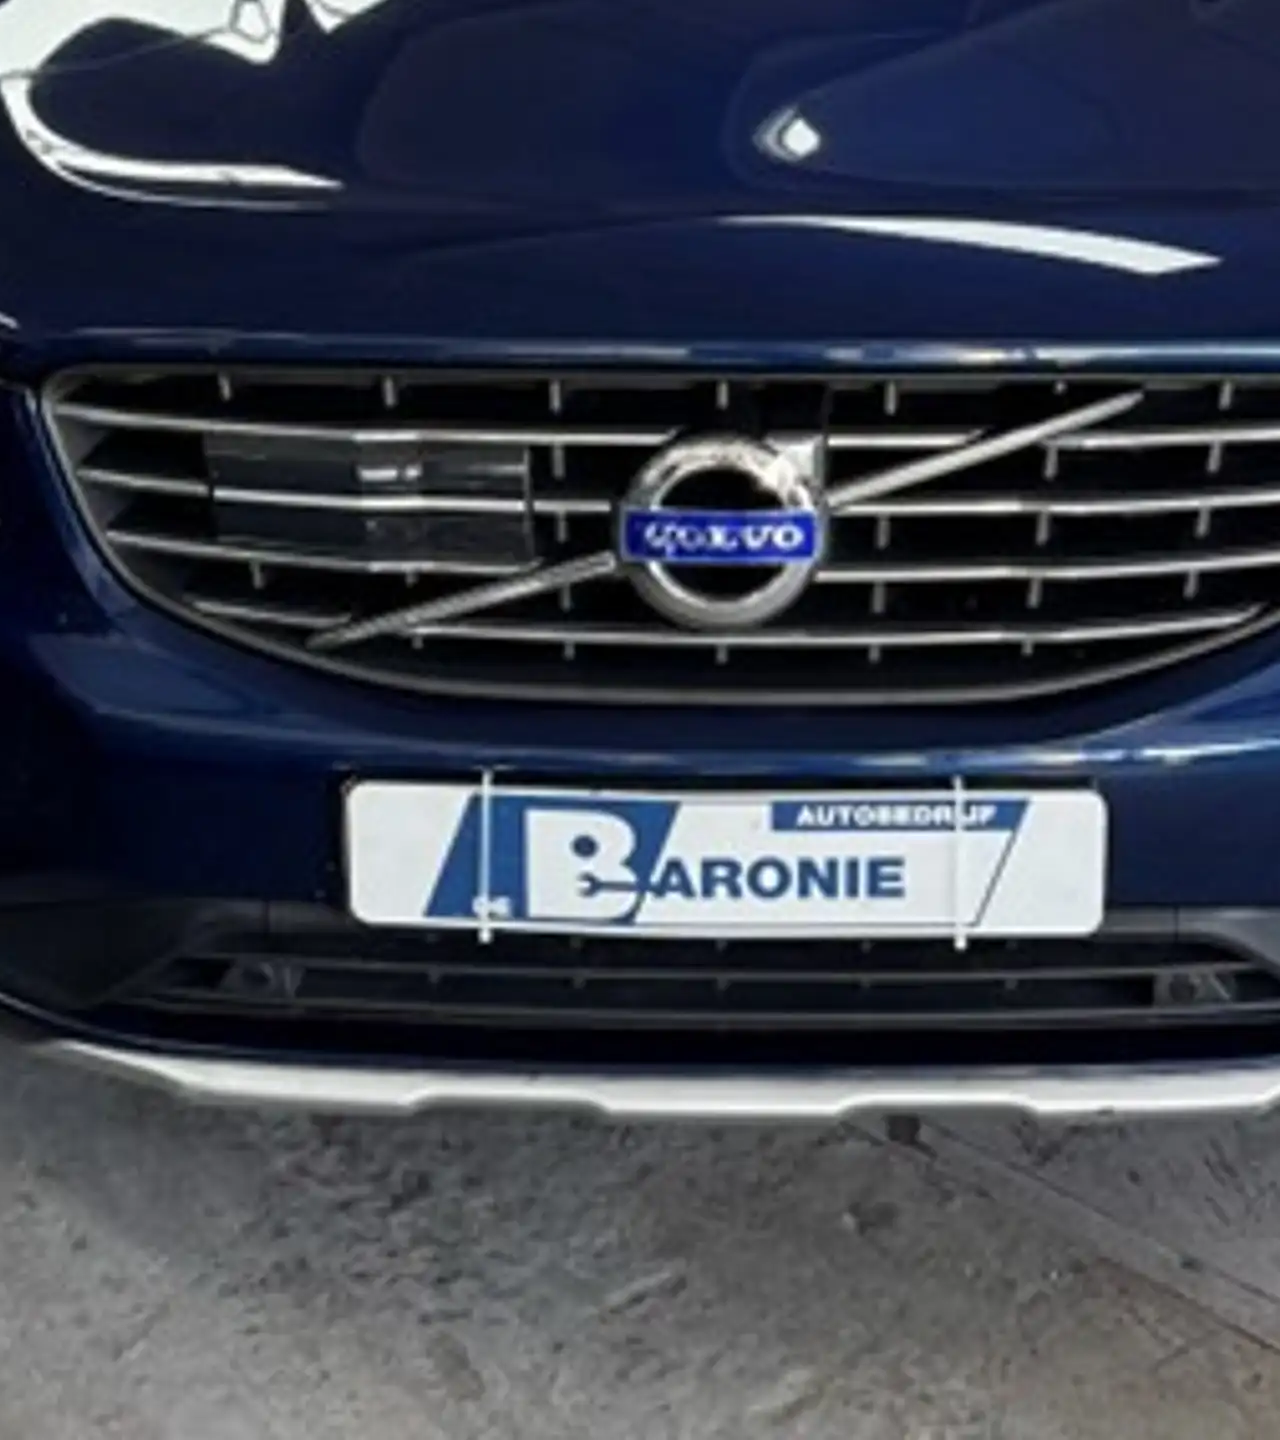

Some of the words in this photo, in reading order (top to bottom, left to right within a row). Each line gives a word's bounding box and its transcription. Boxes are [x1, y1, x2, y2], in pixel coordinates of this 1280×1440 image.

[643, 520, 806, 552] VOLVO
[796, 805, 998, 828] AUTOBEDRJF
[526, 807, 906, 920] BARONIE
